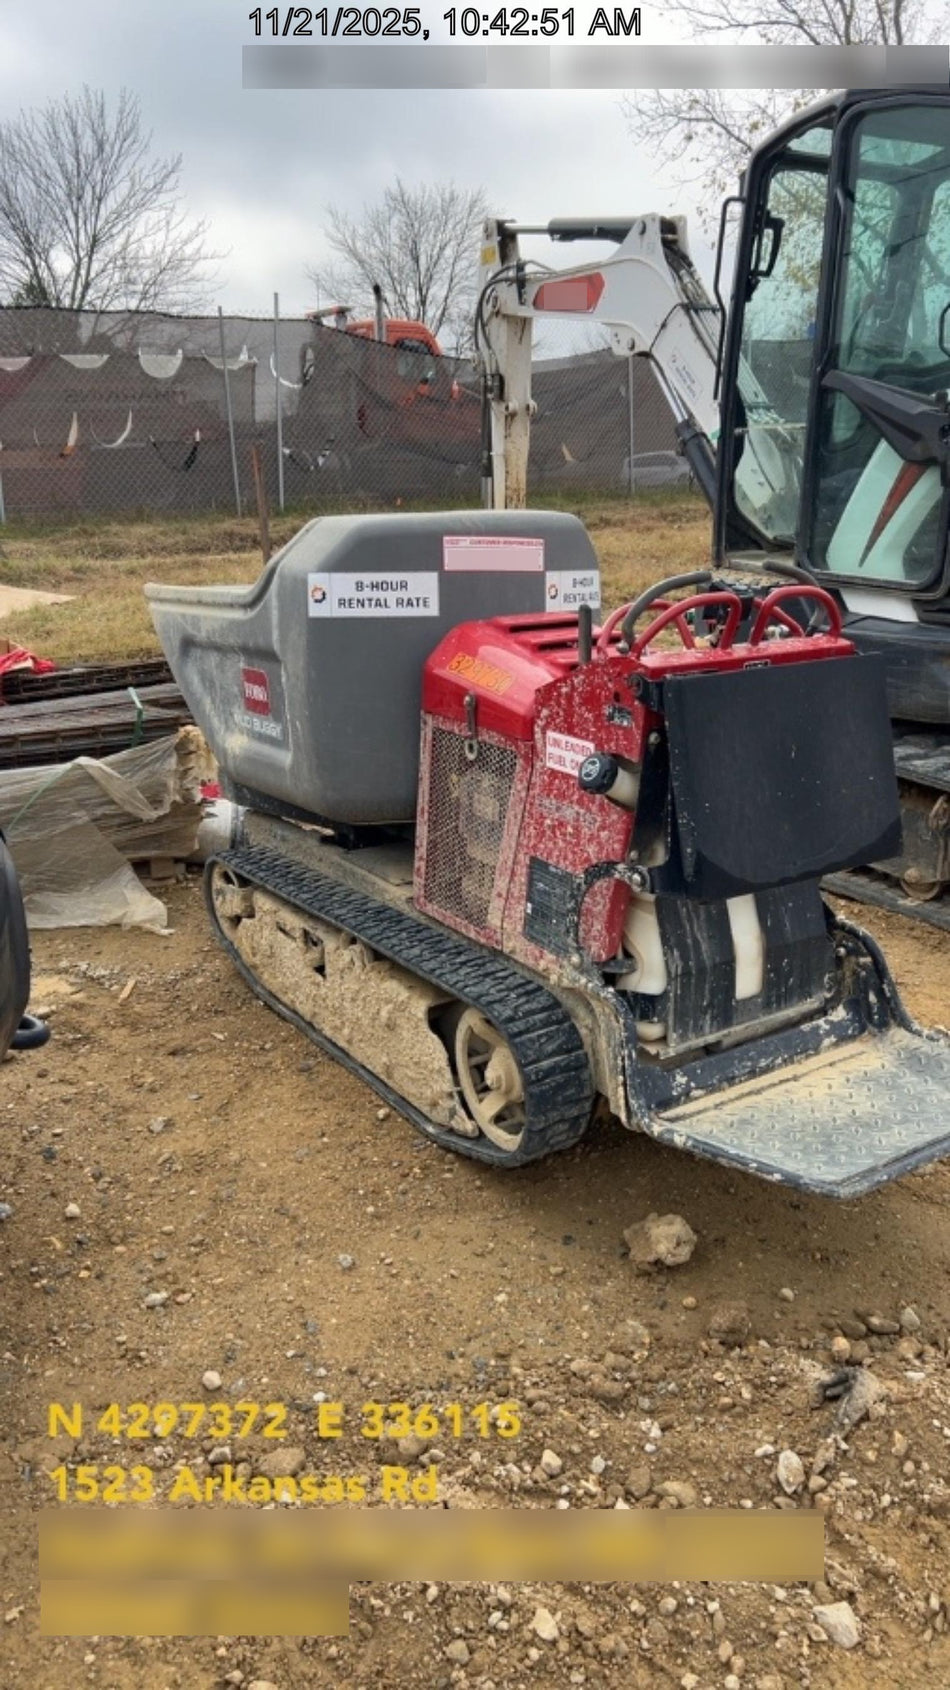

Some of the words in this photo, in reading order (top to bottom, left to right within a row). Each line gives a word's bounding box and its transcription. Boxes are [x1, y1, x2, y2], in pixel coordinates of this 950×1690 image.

[354, 580, 408, 592] 8-HOUR
[338, 598, 391, 609] RENTAL
[396, 597, 430, 608] RATE
[548, 735, 593, 757] UNLEADED
[548, 752, 568, 770] FUEL
